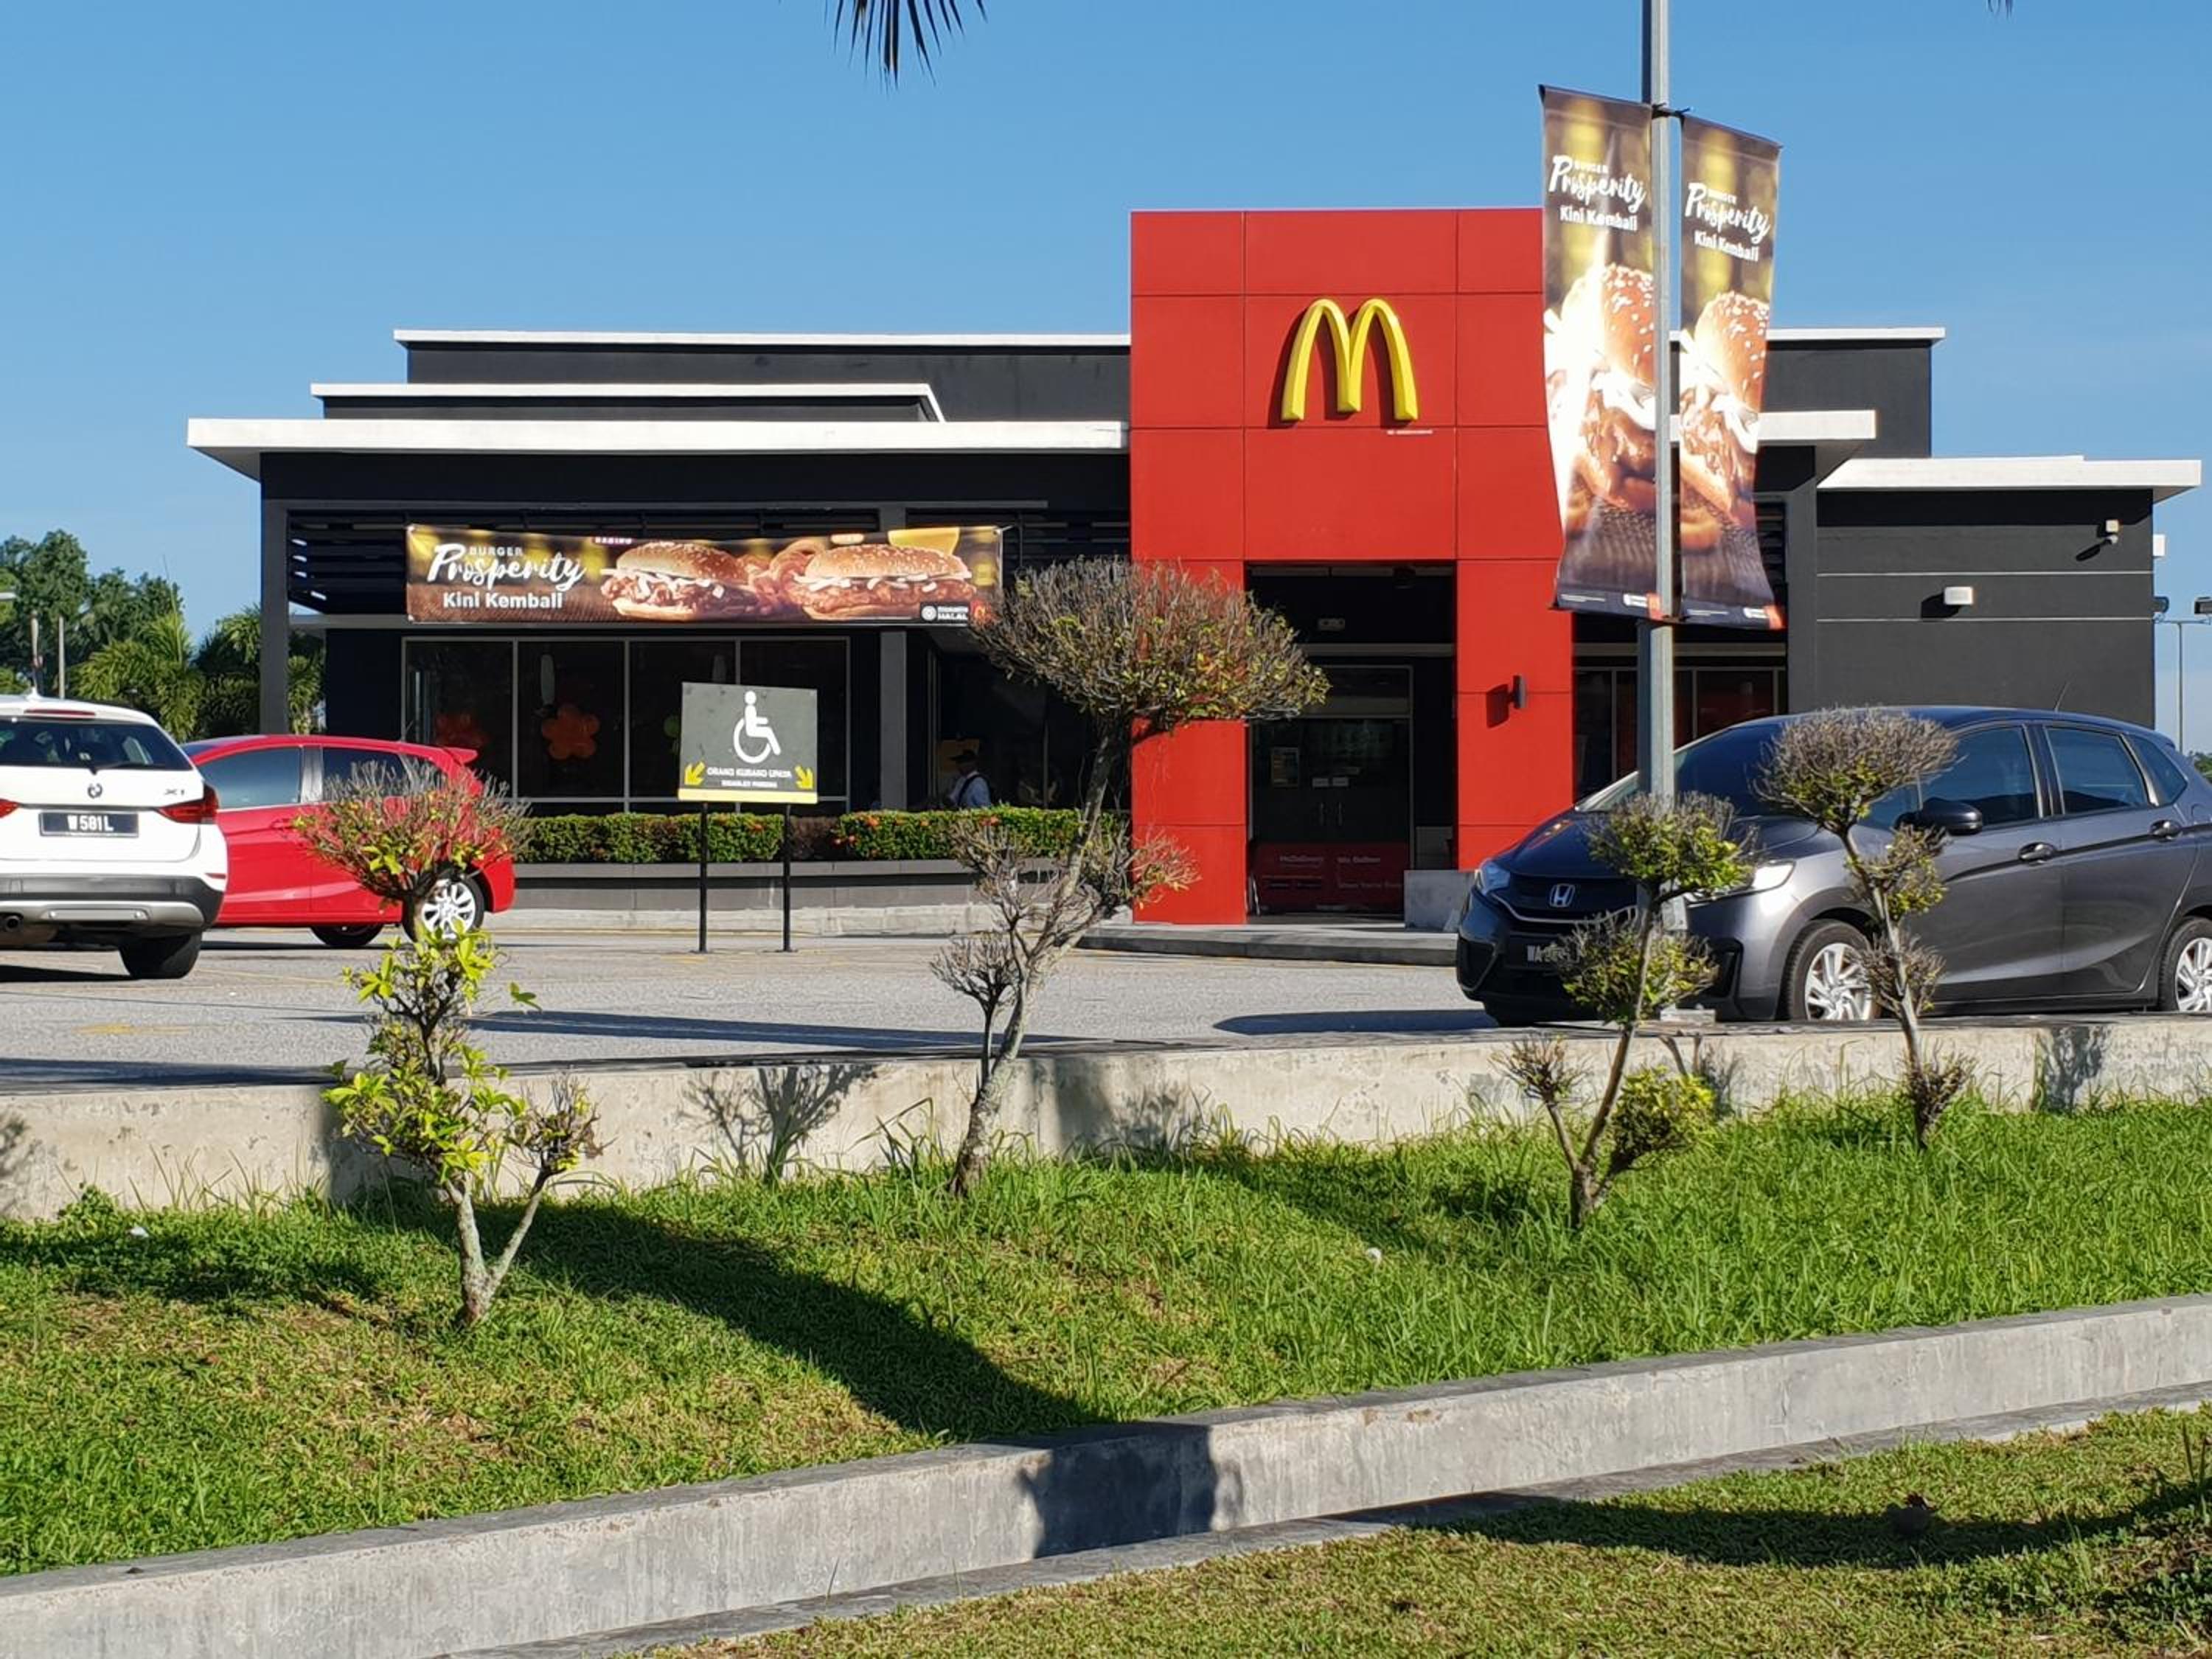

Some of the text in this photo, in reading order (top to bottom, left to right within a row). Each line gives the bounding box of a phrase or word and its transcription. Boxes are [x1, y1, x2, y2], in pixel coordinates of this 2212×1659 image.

[1549, 155, 1646, 213] Prosperity
[1559, 205, 1638, 232] Kini Kembali
[1685, 182, 1770, 244] Prosperity
[1694, 230, 1759, 262] Kini Kembali
[427, 542, 588, 591] Prosperity
[468, 546, 524, 557] BURGER
[443, 591, 563, 610] Kini Kembali
